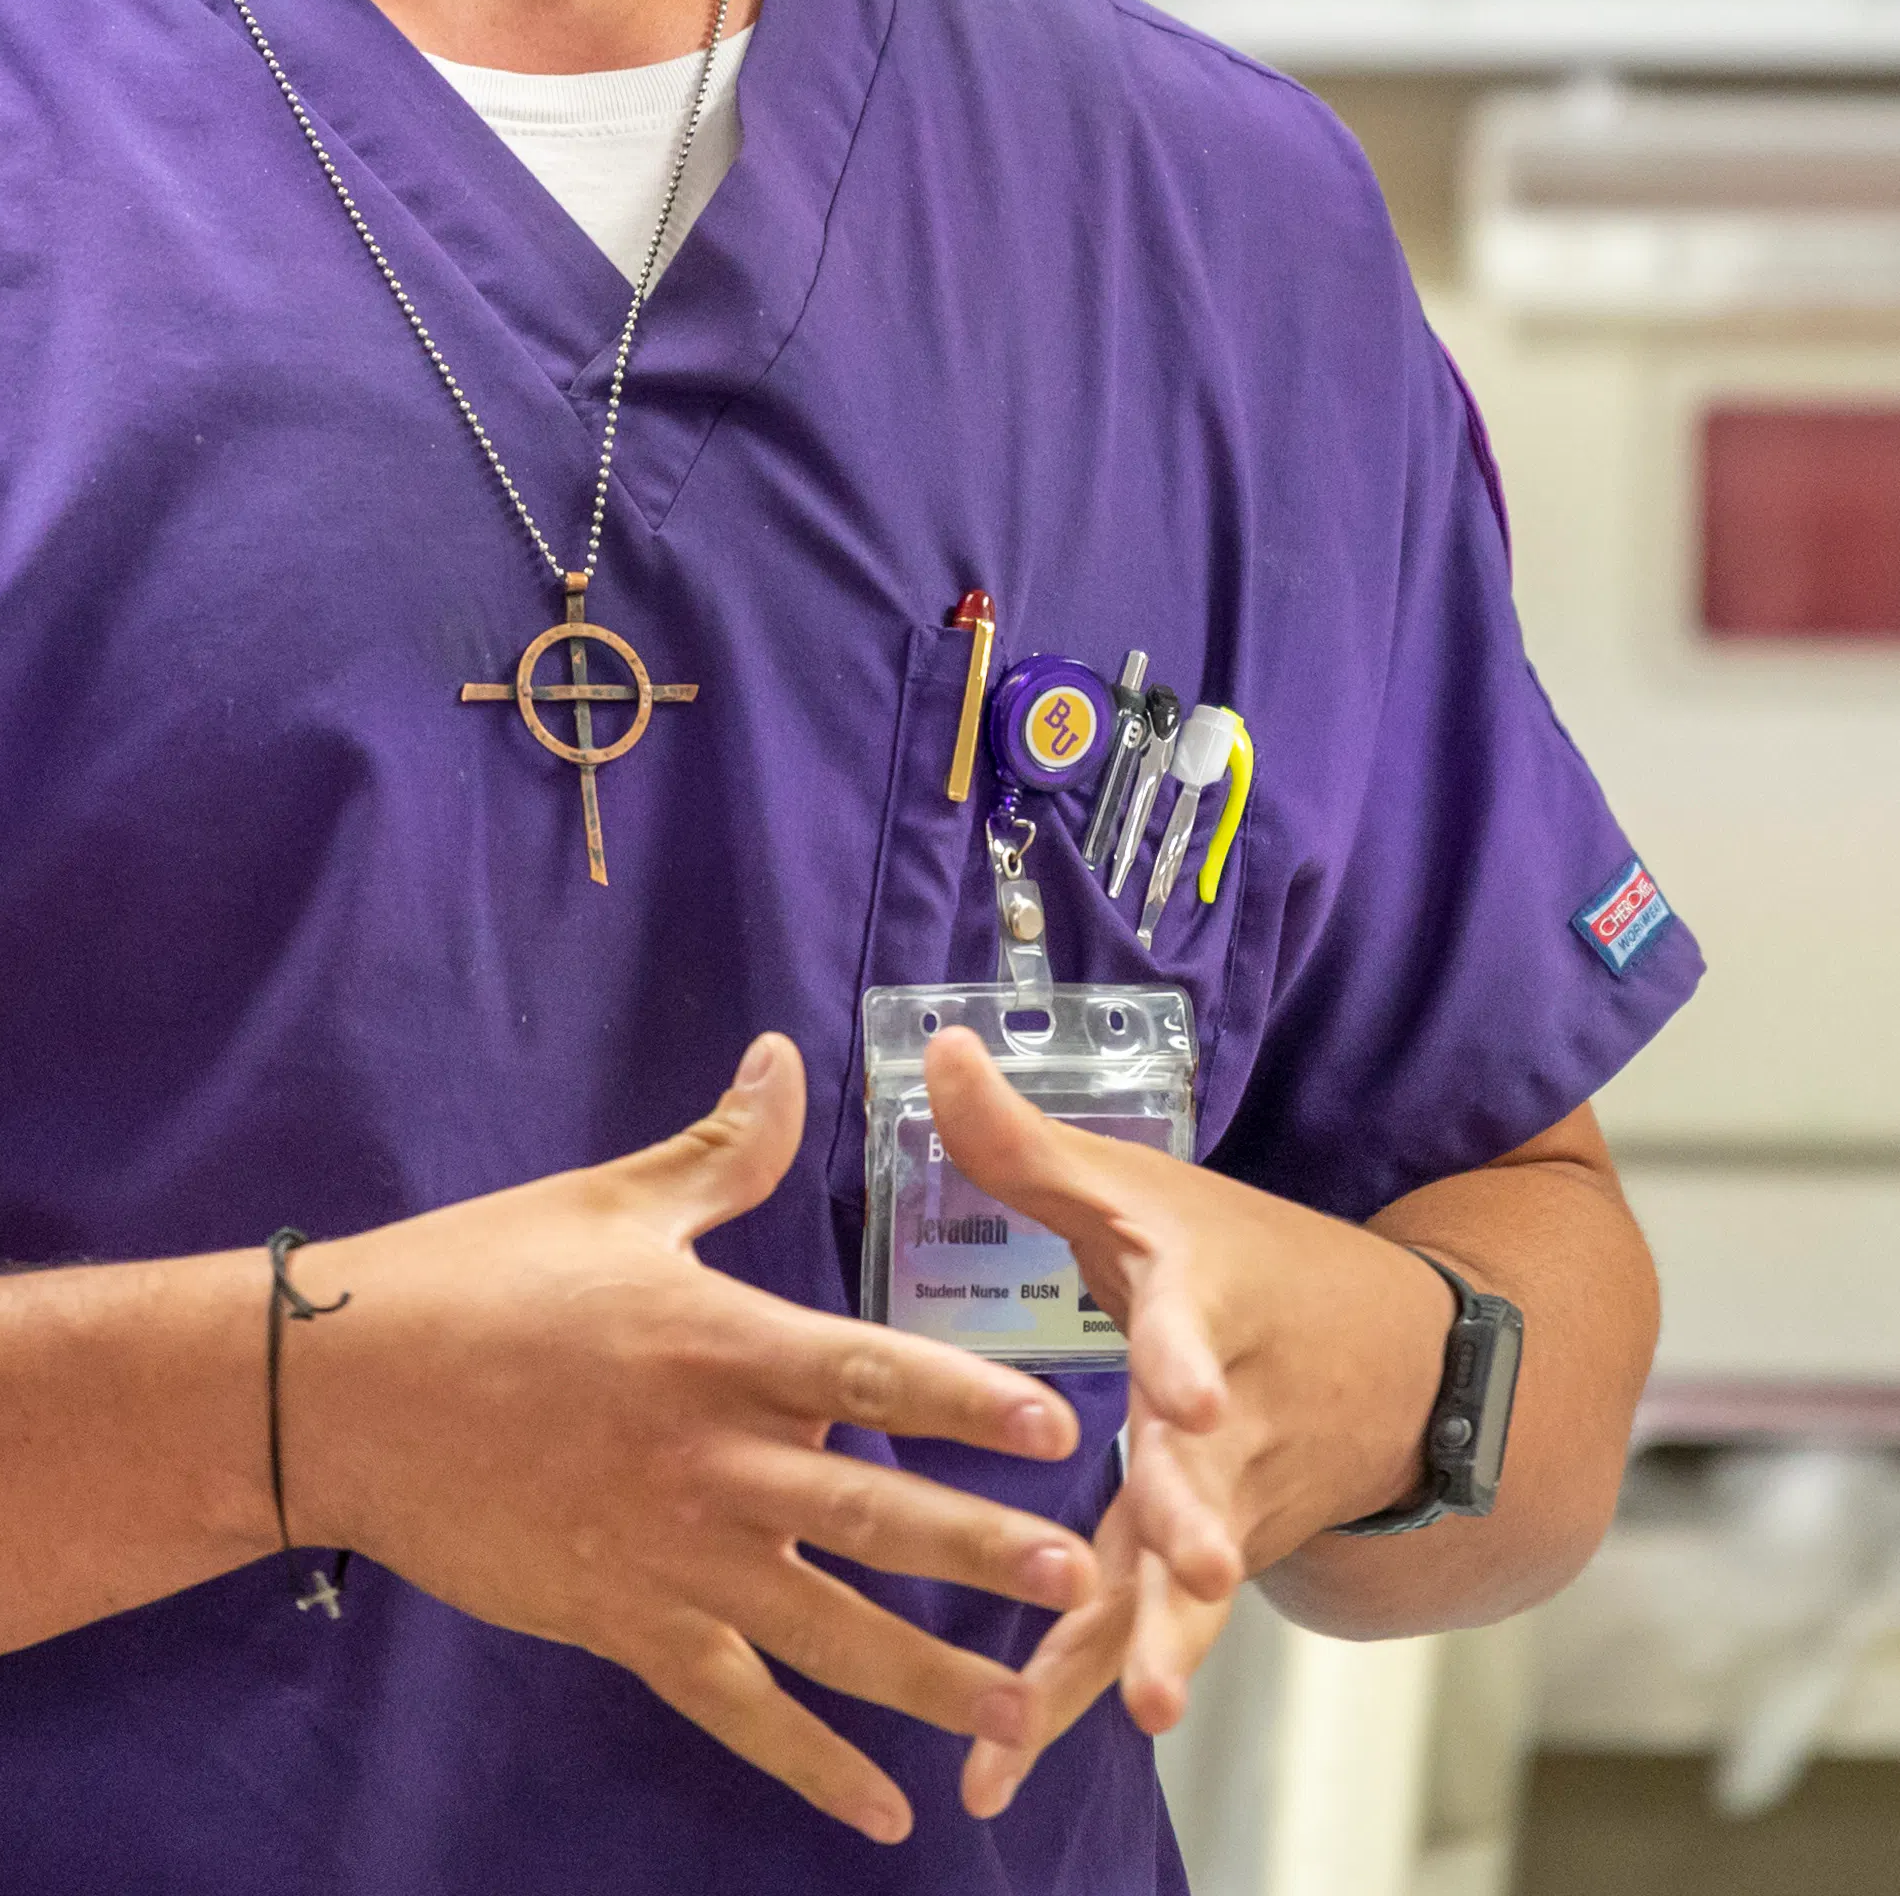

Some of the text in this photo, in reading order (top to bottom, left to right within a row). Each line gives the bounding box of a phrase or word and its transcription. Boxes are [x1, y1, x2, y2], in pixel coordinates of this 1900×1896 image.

[1044, 697, 1079, 756] BU
[915, 1283, 1060, 1299] Student Nurse BUSN
